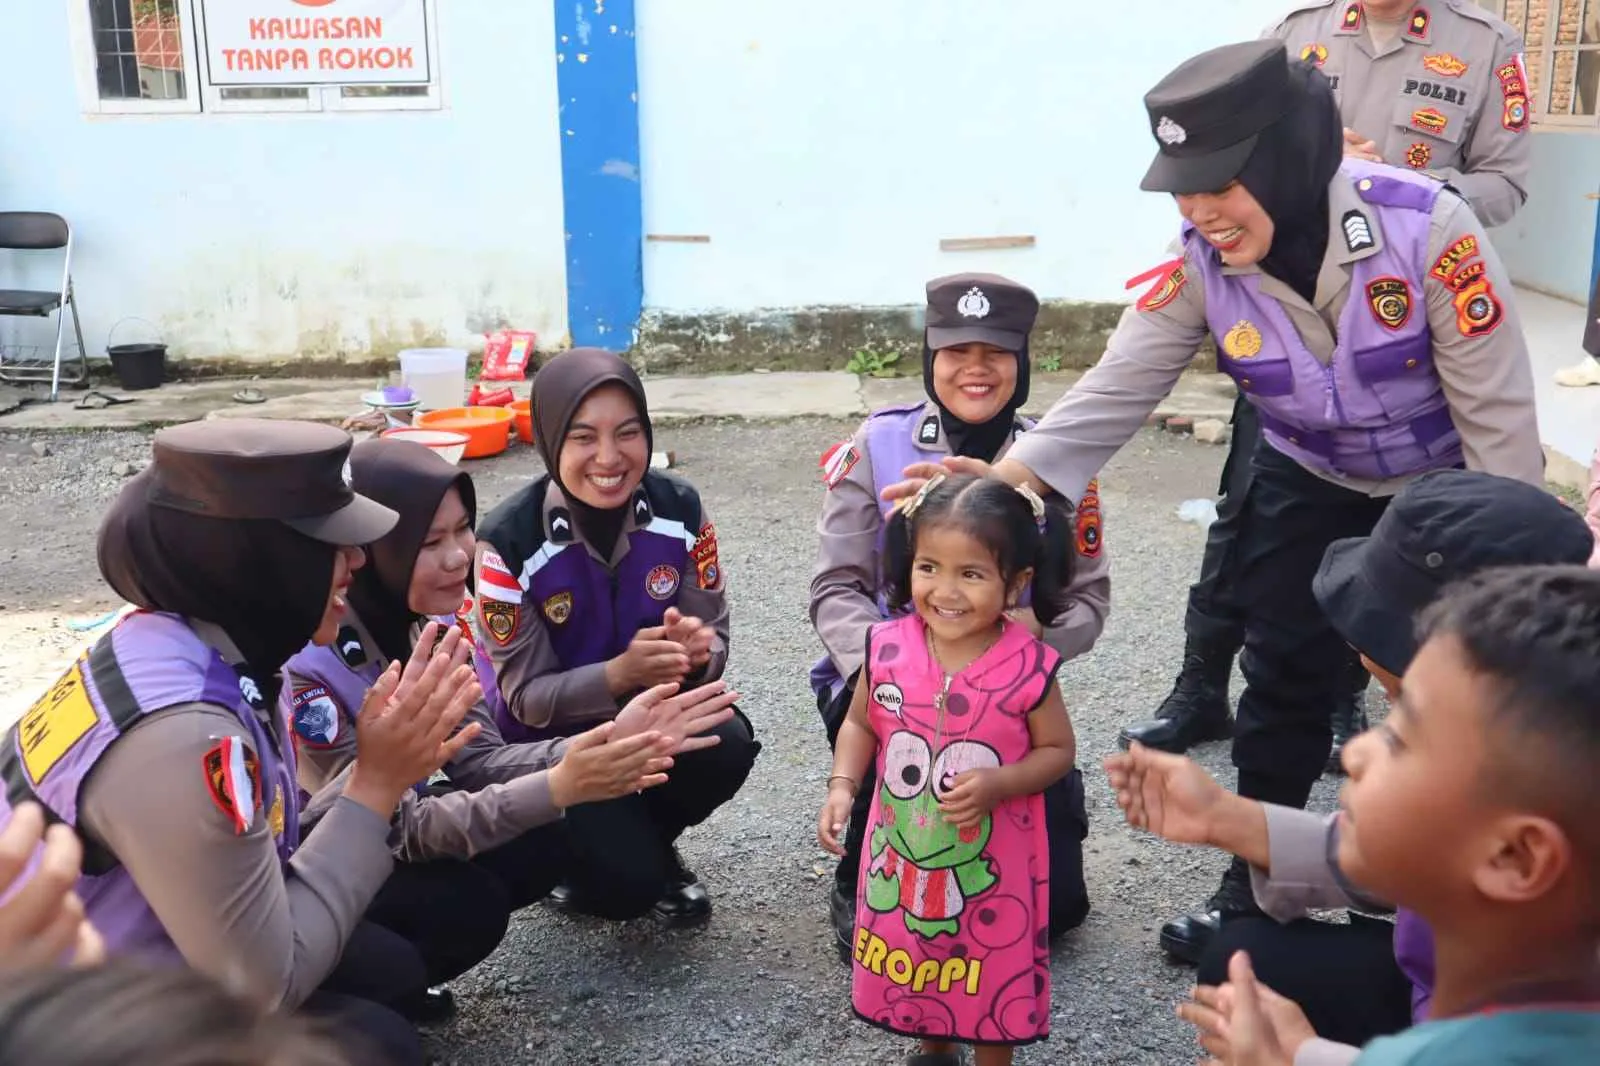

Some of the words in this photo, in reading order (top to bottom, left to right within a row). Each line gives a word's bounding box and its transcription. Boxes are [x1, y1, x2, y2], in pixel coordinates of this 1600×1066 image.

[249, 16, 383, 39] KAWASAN
[222, 48, 309, 71] TANPA
[318, 47, 413, 70] ROKOK
[1404, 79, 1467, 106] POLRI
[854, 926, 982, 996] EROPPI
